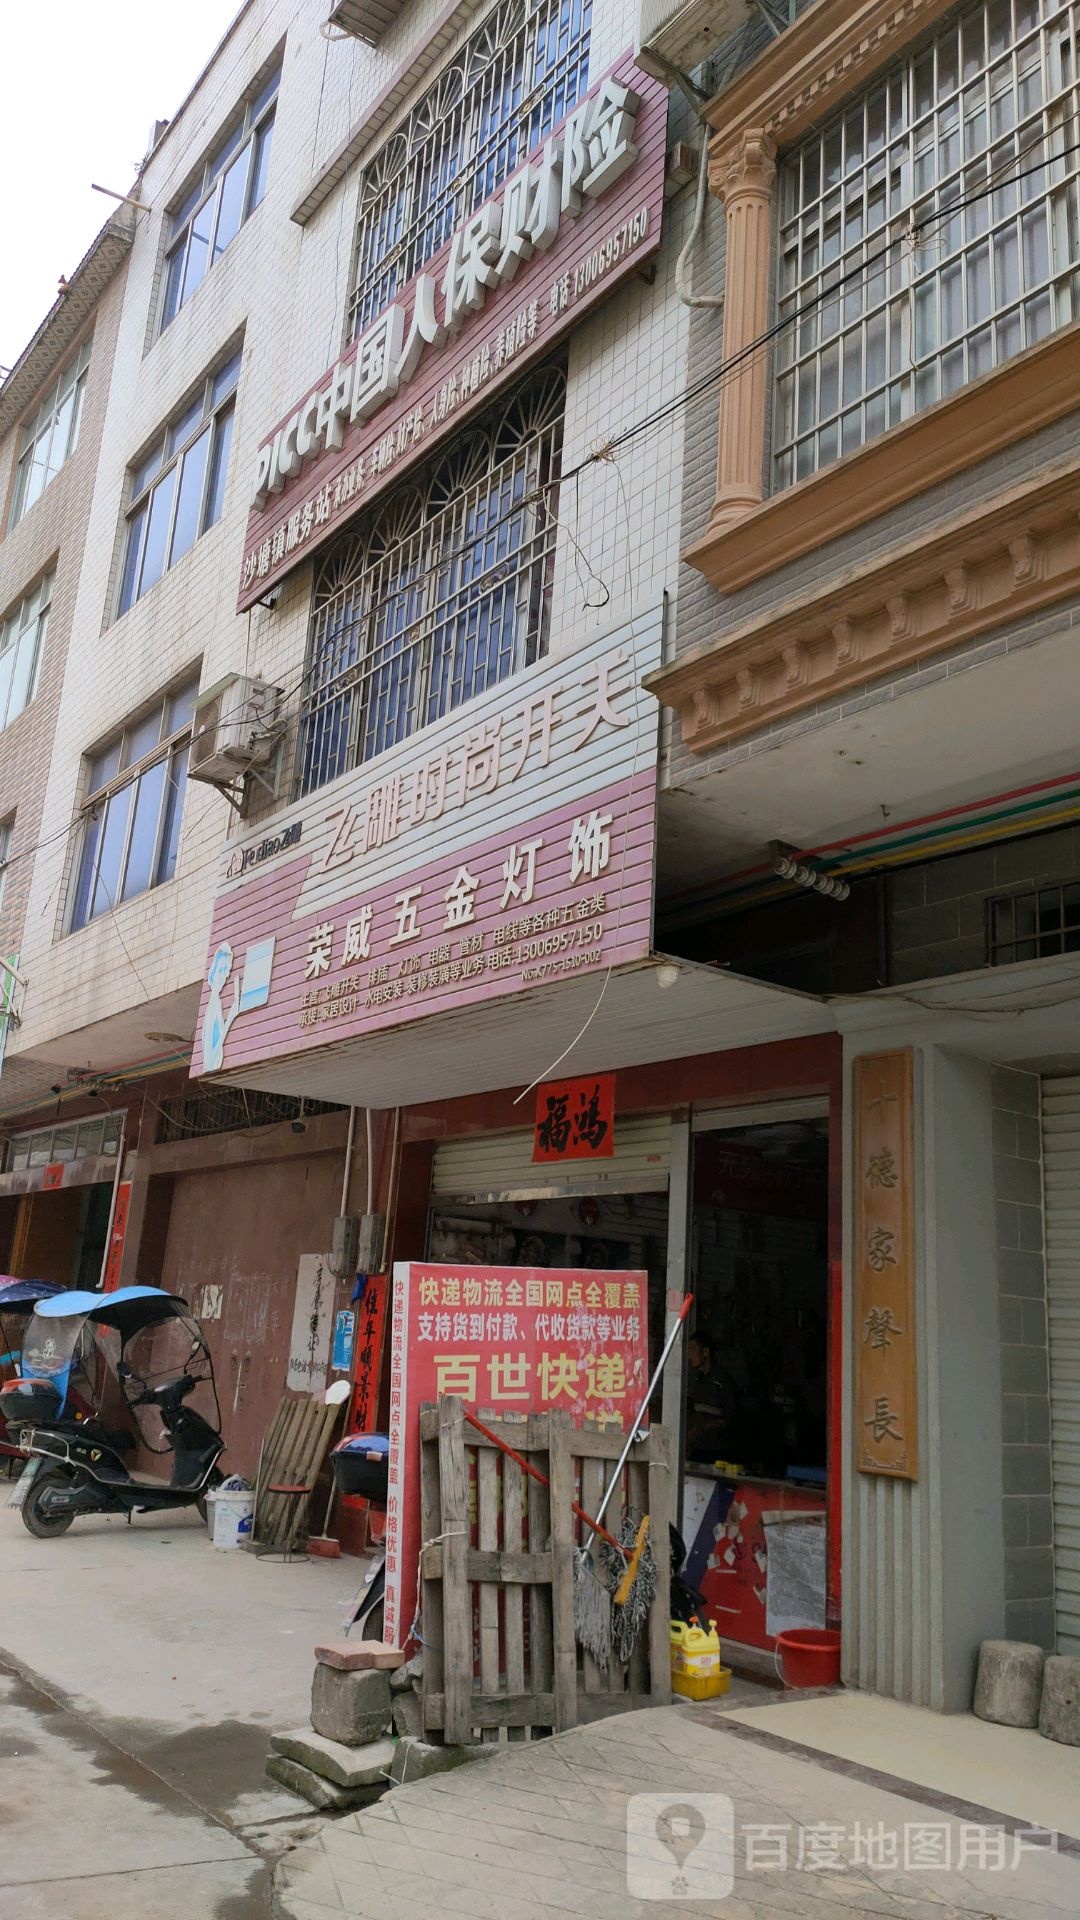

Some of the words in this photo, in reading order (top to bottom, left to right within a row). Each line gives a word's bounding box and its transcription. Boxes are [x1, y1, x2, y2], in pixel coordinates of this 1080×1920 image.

[549, 270, 569, 316] 电话
[574, 206, 649, 296] 13006957150
[318, 648, 630, 874] 飞雕时尚开关
[304, 809, 614, 979] 荣威五金灯饰
[399, 953, 420, 976] 灯饰
[429, 944, 450, 965] 电器
[459, 933, 483, 956] 管材
[494, 892, 606, 943] 电线等各种五金类
[364, 980, 403, 1009] 水电安装
[417, 1312, 640, 1342] 支持货到付款、代收货款等业务
[418, 1276, 640, 1309] 快递物流全国网点全覆盖
[389, 1280, 404, 1486] 快递物流全国网点全覆盖
[433, 1352, 626, 1402] 百世快递
[385, 1496, 398, 1573] 价格优惠
